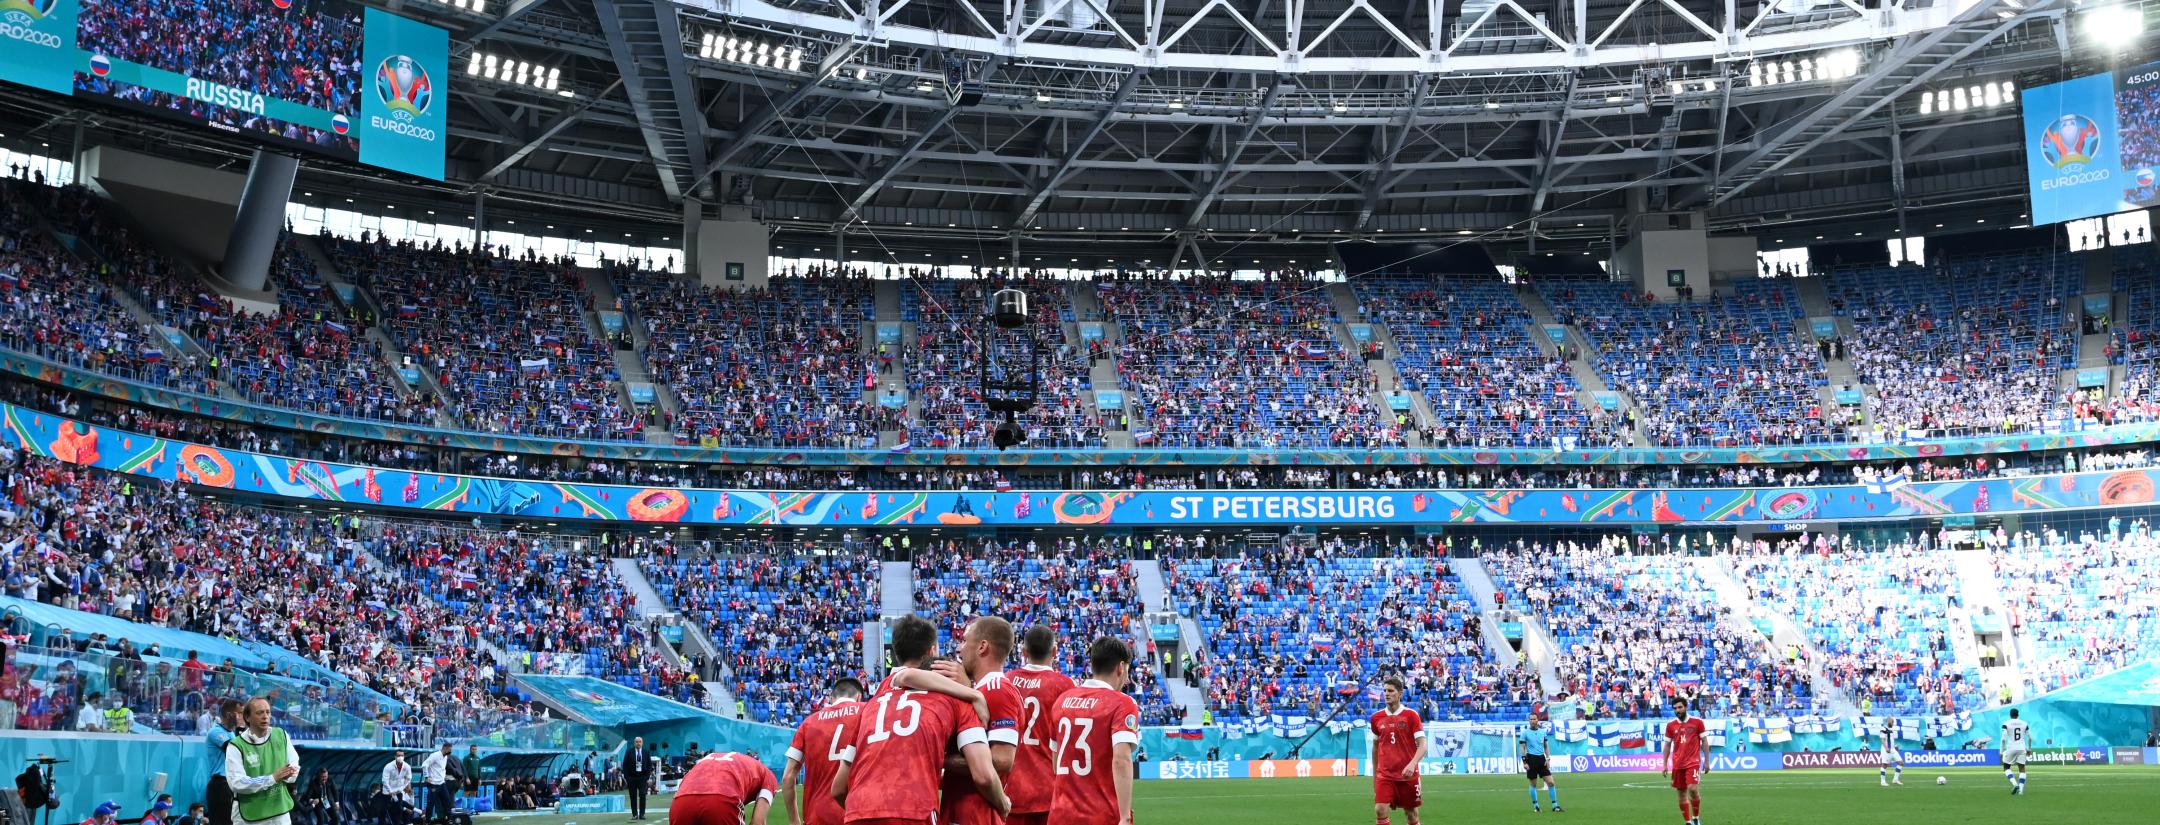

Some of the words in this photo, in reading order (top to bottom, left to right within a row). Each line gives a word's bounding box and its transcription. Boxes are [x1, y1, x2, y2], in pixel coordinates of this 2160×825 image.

[2127, 71, 2160, 85] 45:00
[186, 77, 265, 115] RUSSIA
[208, 120, 240, 133] Hisense
[371, 115, 435, 141] EURO2020
[2041, 169, 2110, 190] EURO2020
[1170, 496, 1203, 518] ST
[1212, 496, 1395, 518] PETERSBURG
[1012, 675, 1041, 688] DZYUBA
[818, 705, 860, 721] KARAVAEV
[867, 690, 928, 744] 15
[1390, 732, 1396, 744] 3
[2014, 727, 2021, 741] 6
[1056, 716, 1094, 776] 23
[1783, 754, 1829, 767] QATAR
[1832, 752, 1882, 765] AIRWAY
[1904, 751, 1986, 765] Booking.com
[2026, 751, 2074, 762] eineken
